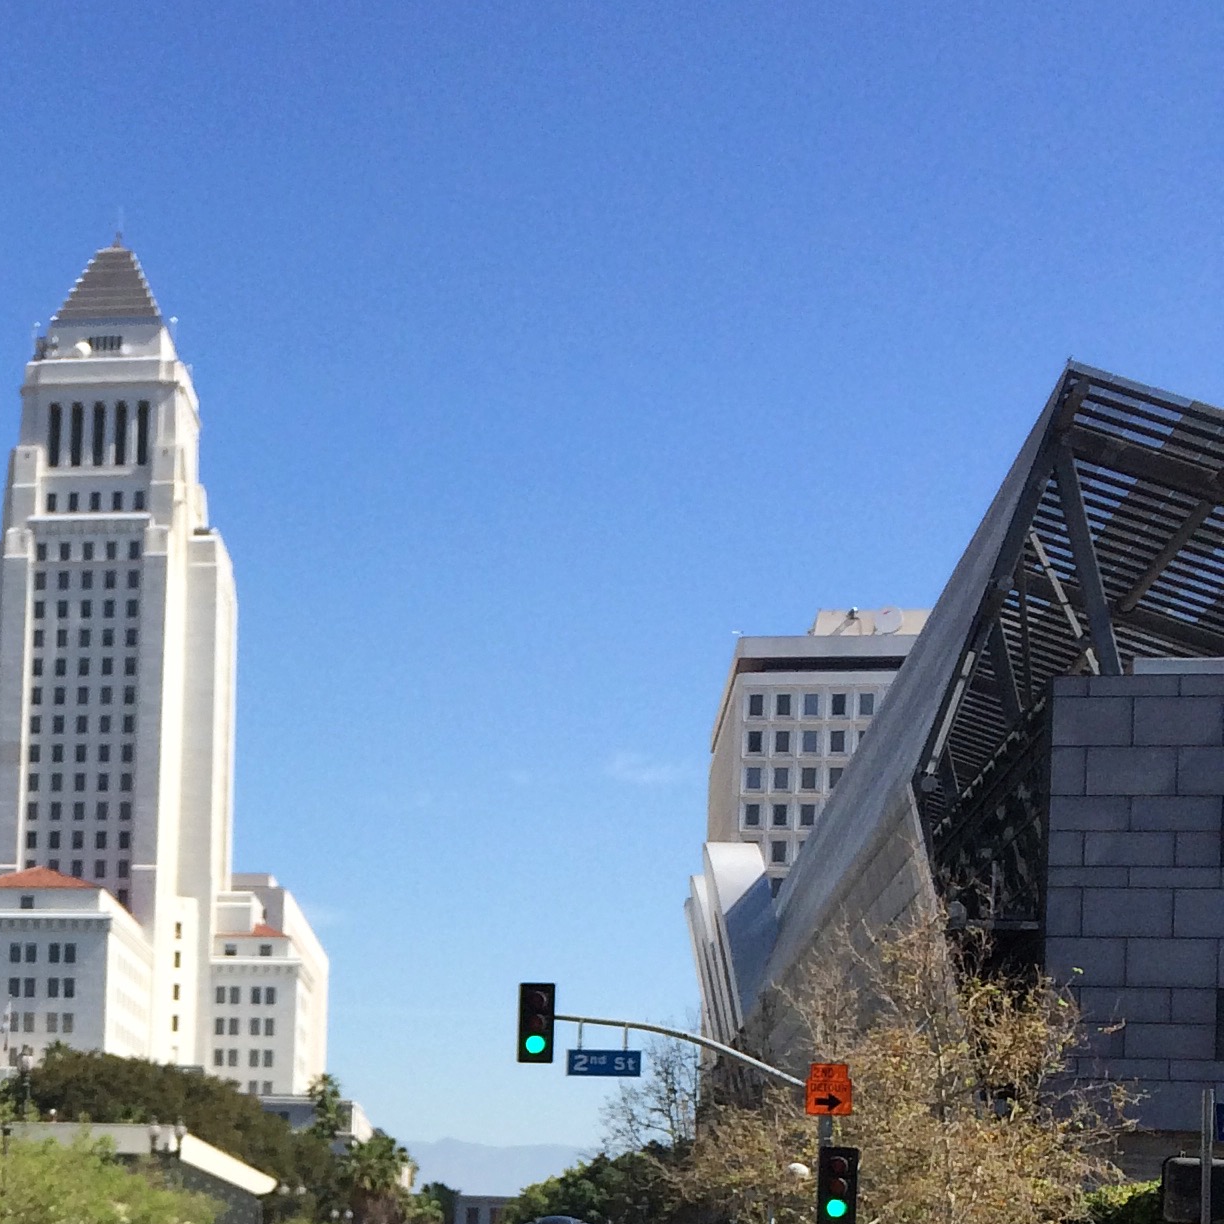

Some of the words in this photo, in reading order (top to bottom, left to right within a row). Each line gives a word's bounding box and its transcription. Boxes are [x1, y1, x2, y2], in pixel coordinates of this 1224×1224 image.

[573, 1054, 607, 1071] 2nd
[613, 1056, 636, 1071] St
[810, 1082, 849, 1092] DETOUR
